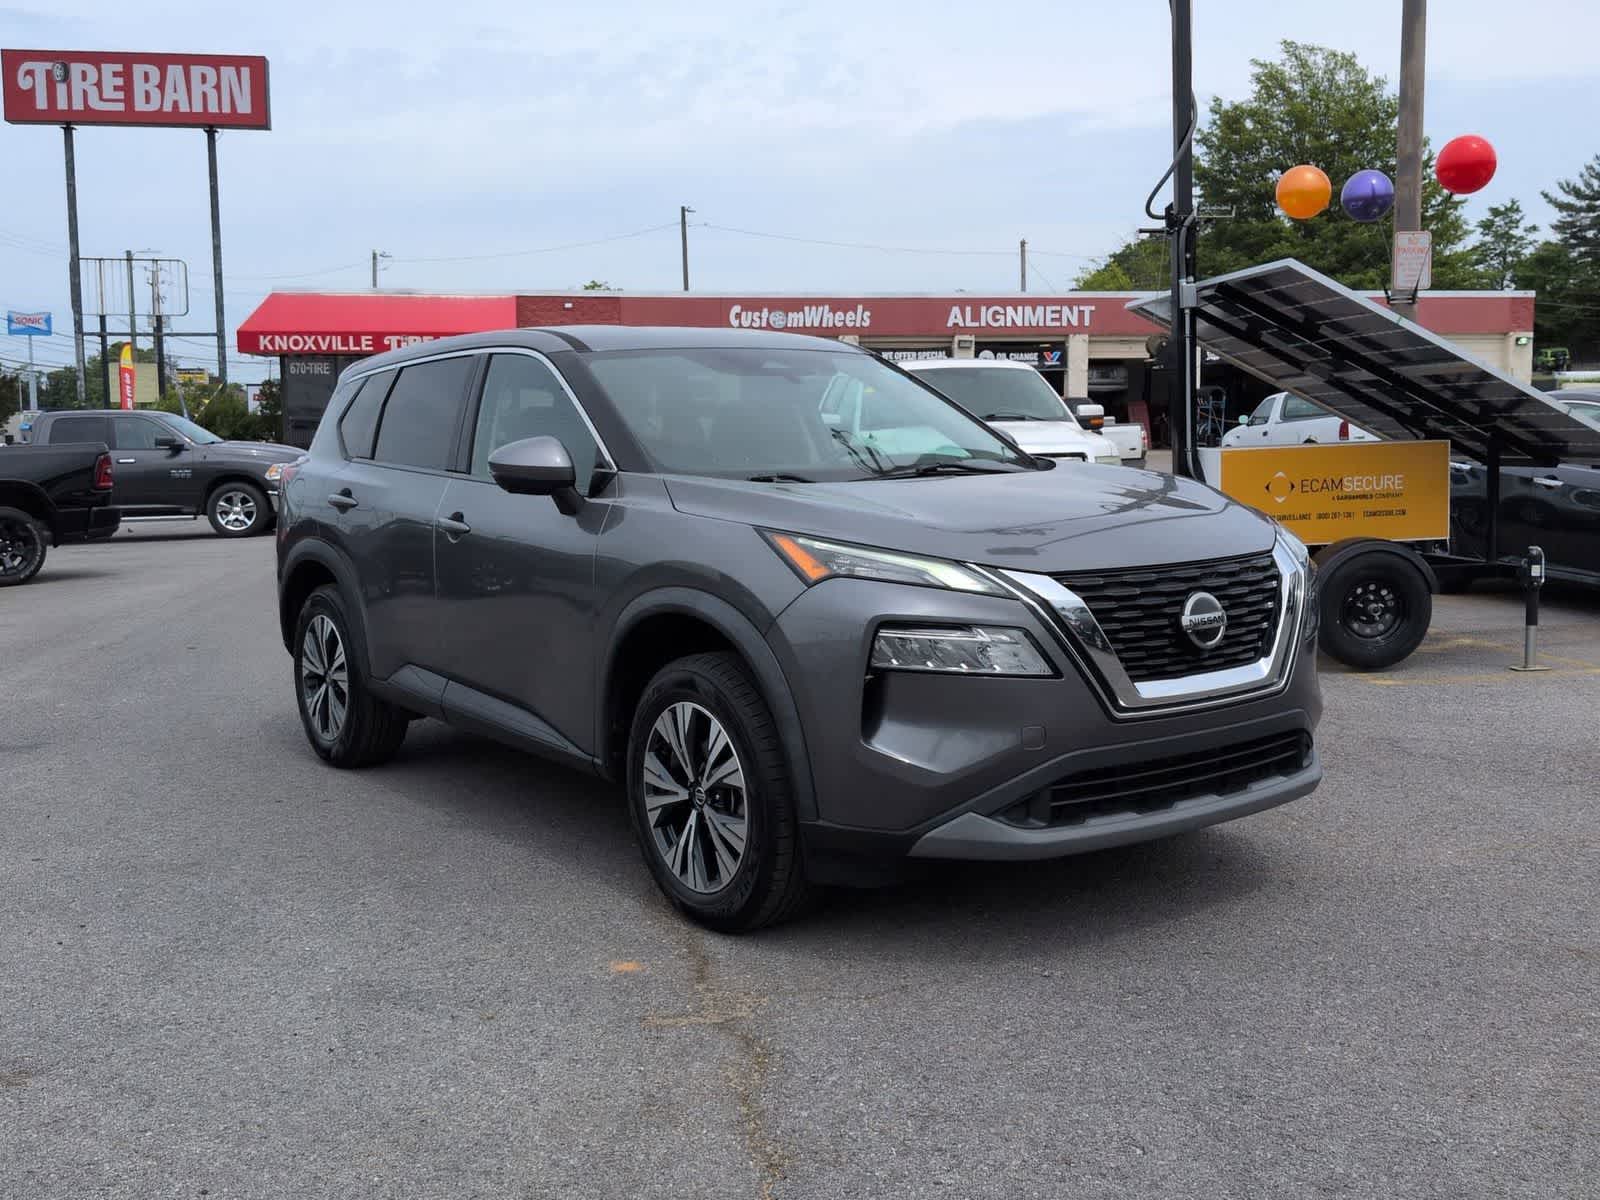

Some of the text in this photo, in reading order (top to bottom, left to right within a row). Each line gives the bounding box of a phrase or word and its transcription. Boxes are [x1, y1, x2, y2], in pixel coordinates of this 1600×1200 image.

[132, 63, 252, 114] BARN
[15, 317, 43, 325] SONIC
[947, 305, 1096, 328] ALIGNMENT
[258, 335, 374, 351] KNOXVILLE
[1008, 352, 1039, 361] CHANGE
[289, 362, 330, 375] 670-TIRE
[1300, 475, 1404, 493] ECAMSECURE
[1189, 615, 1225, 626] NISSAN
